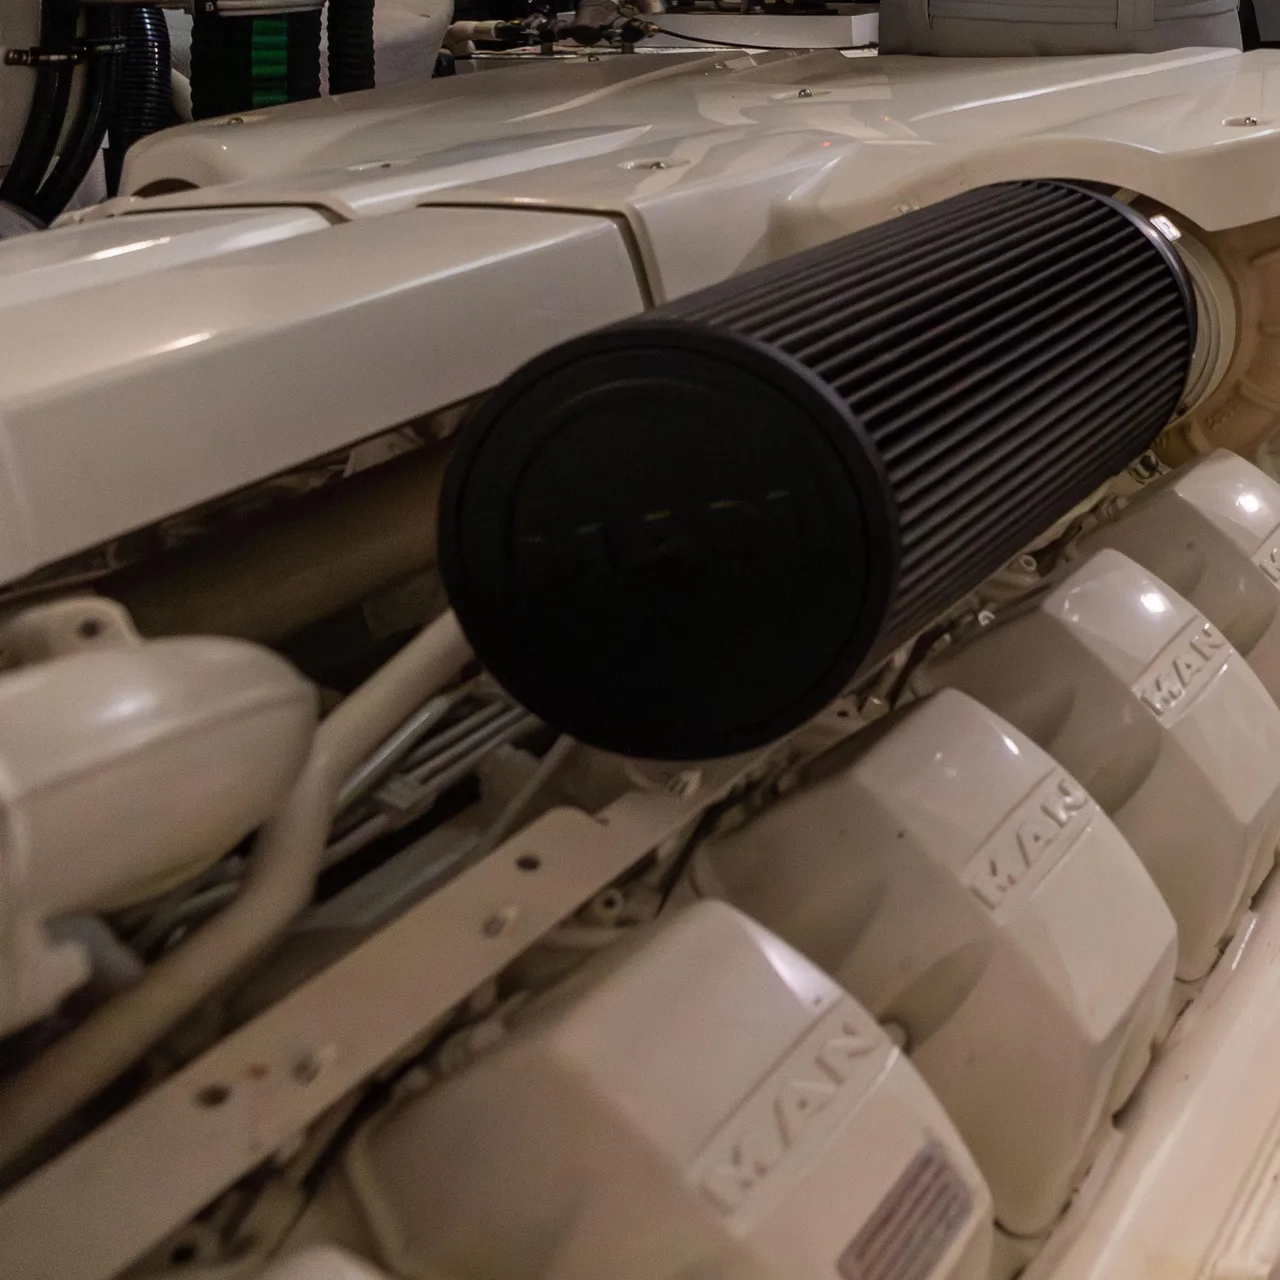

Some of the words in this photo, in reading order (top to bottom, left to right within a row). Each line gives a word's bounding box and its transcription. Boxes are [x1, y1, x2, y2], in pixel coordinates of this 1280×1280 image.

[1140, 622, 1228, 717] MAN
[970, 777, 1091, 911] MAN
[701, 1019, 876, 1215] MAN
